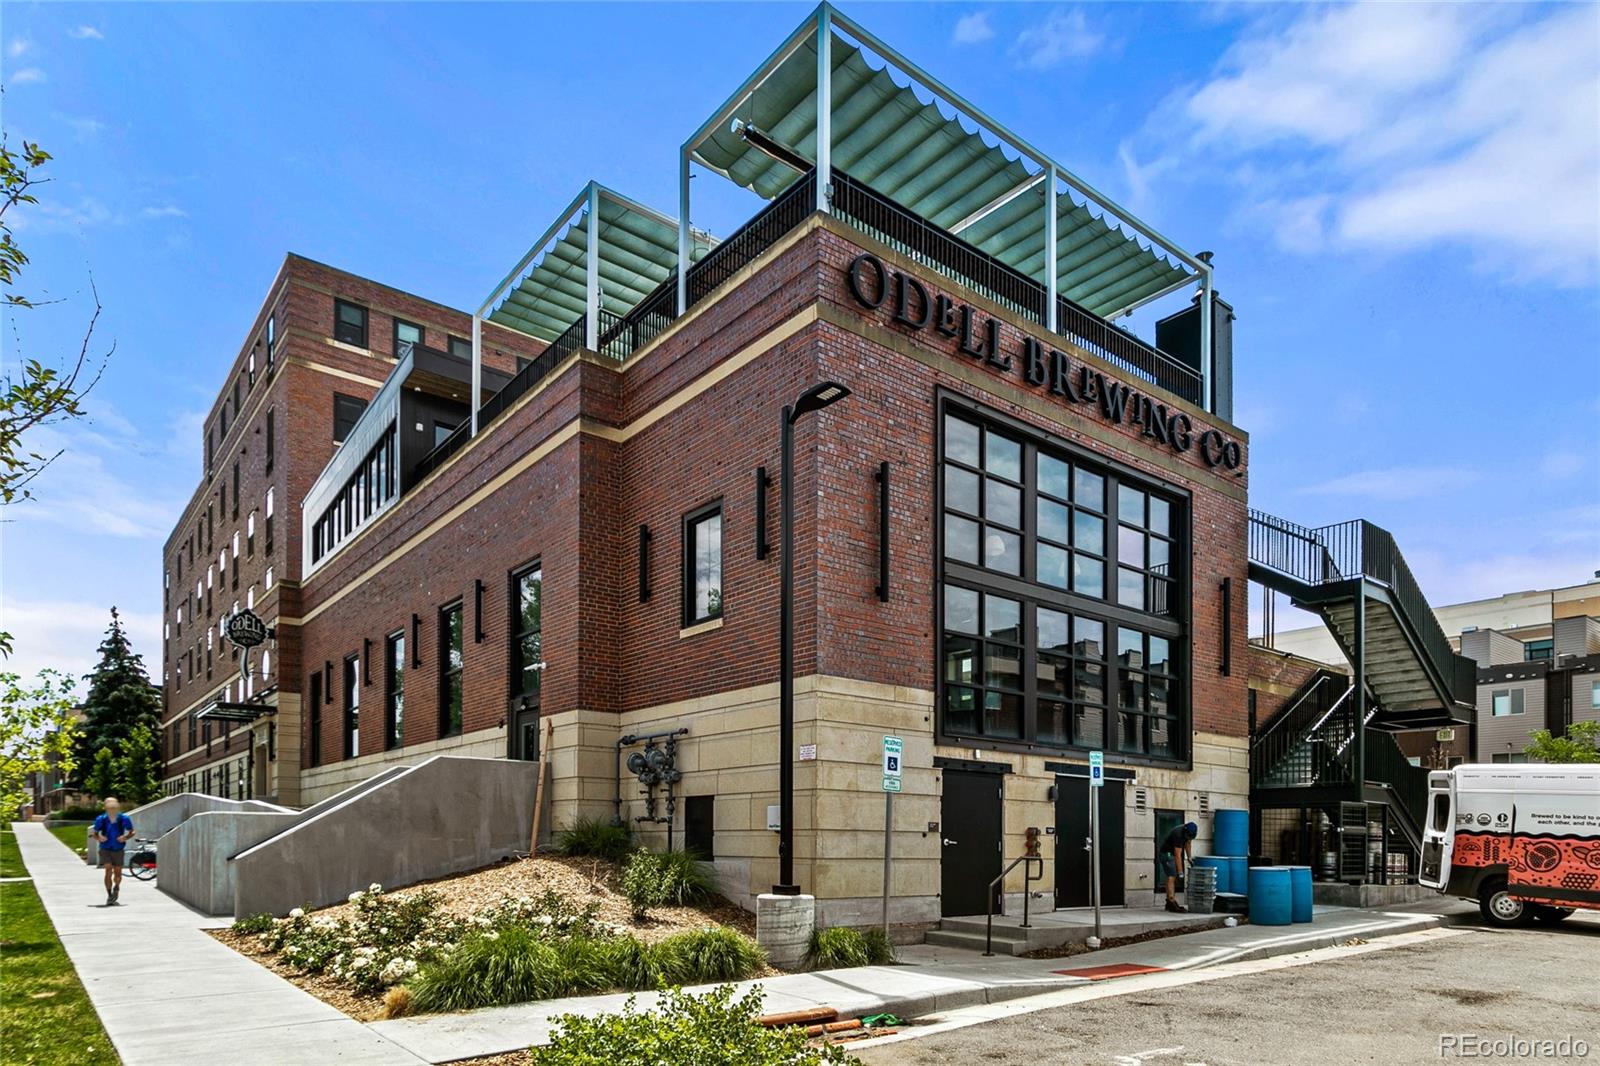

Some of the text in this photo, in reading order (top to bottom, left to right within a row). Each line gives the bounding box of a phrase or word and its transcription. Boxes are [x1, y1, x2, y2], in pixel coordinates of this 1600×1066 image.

[848, 252, 1012, 373] ODELL
[1023, 336, 1193, 453] BREWING
[231, 614, 263, 635] ODELL
